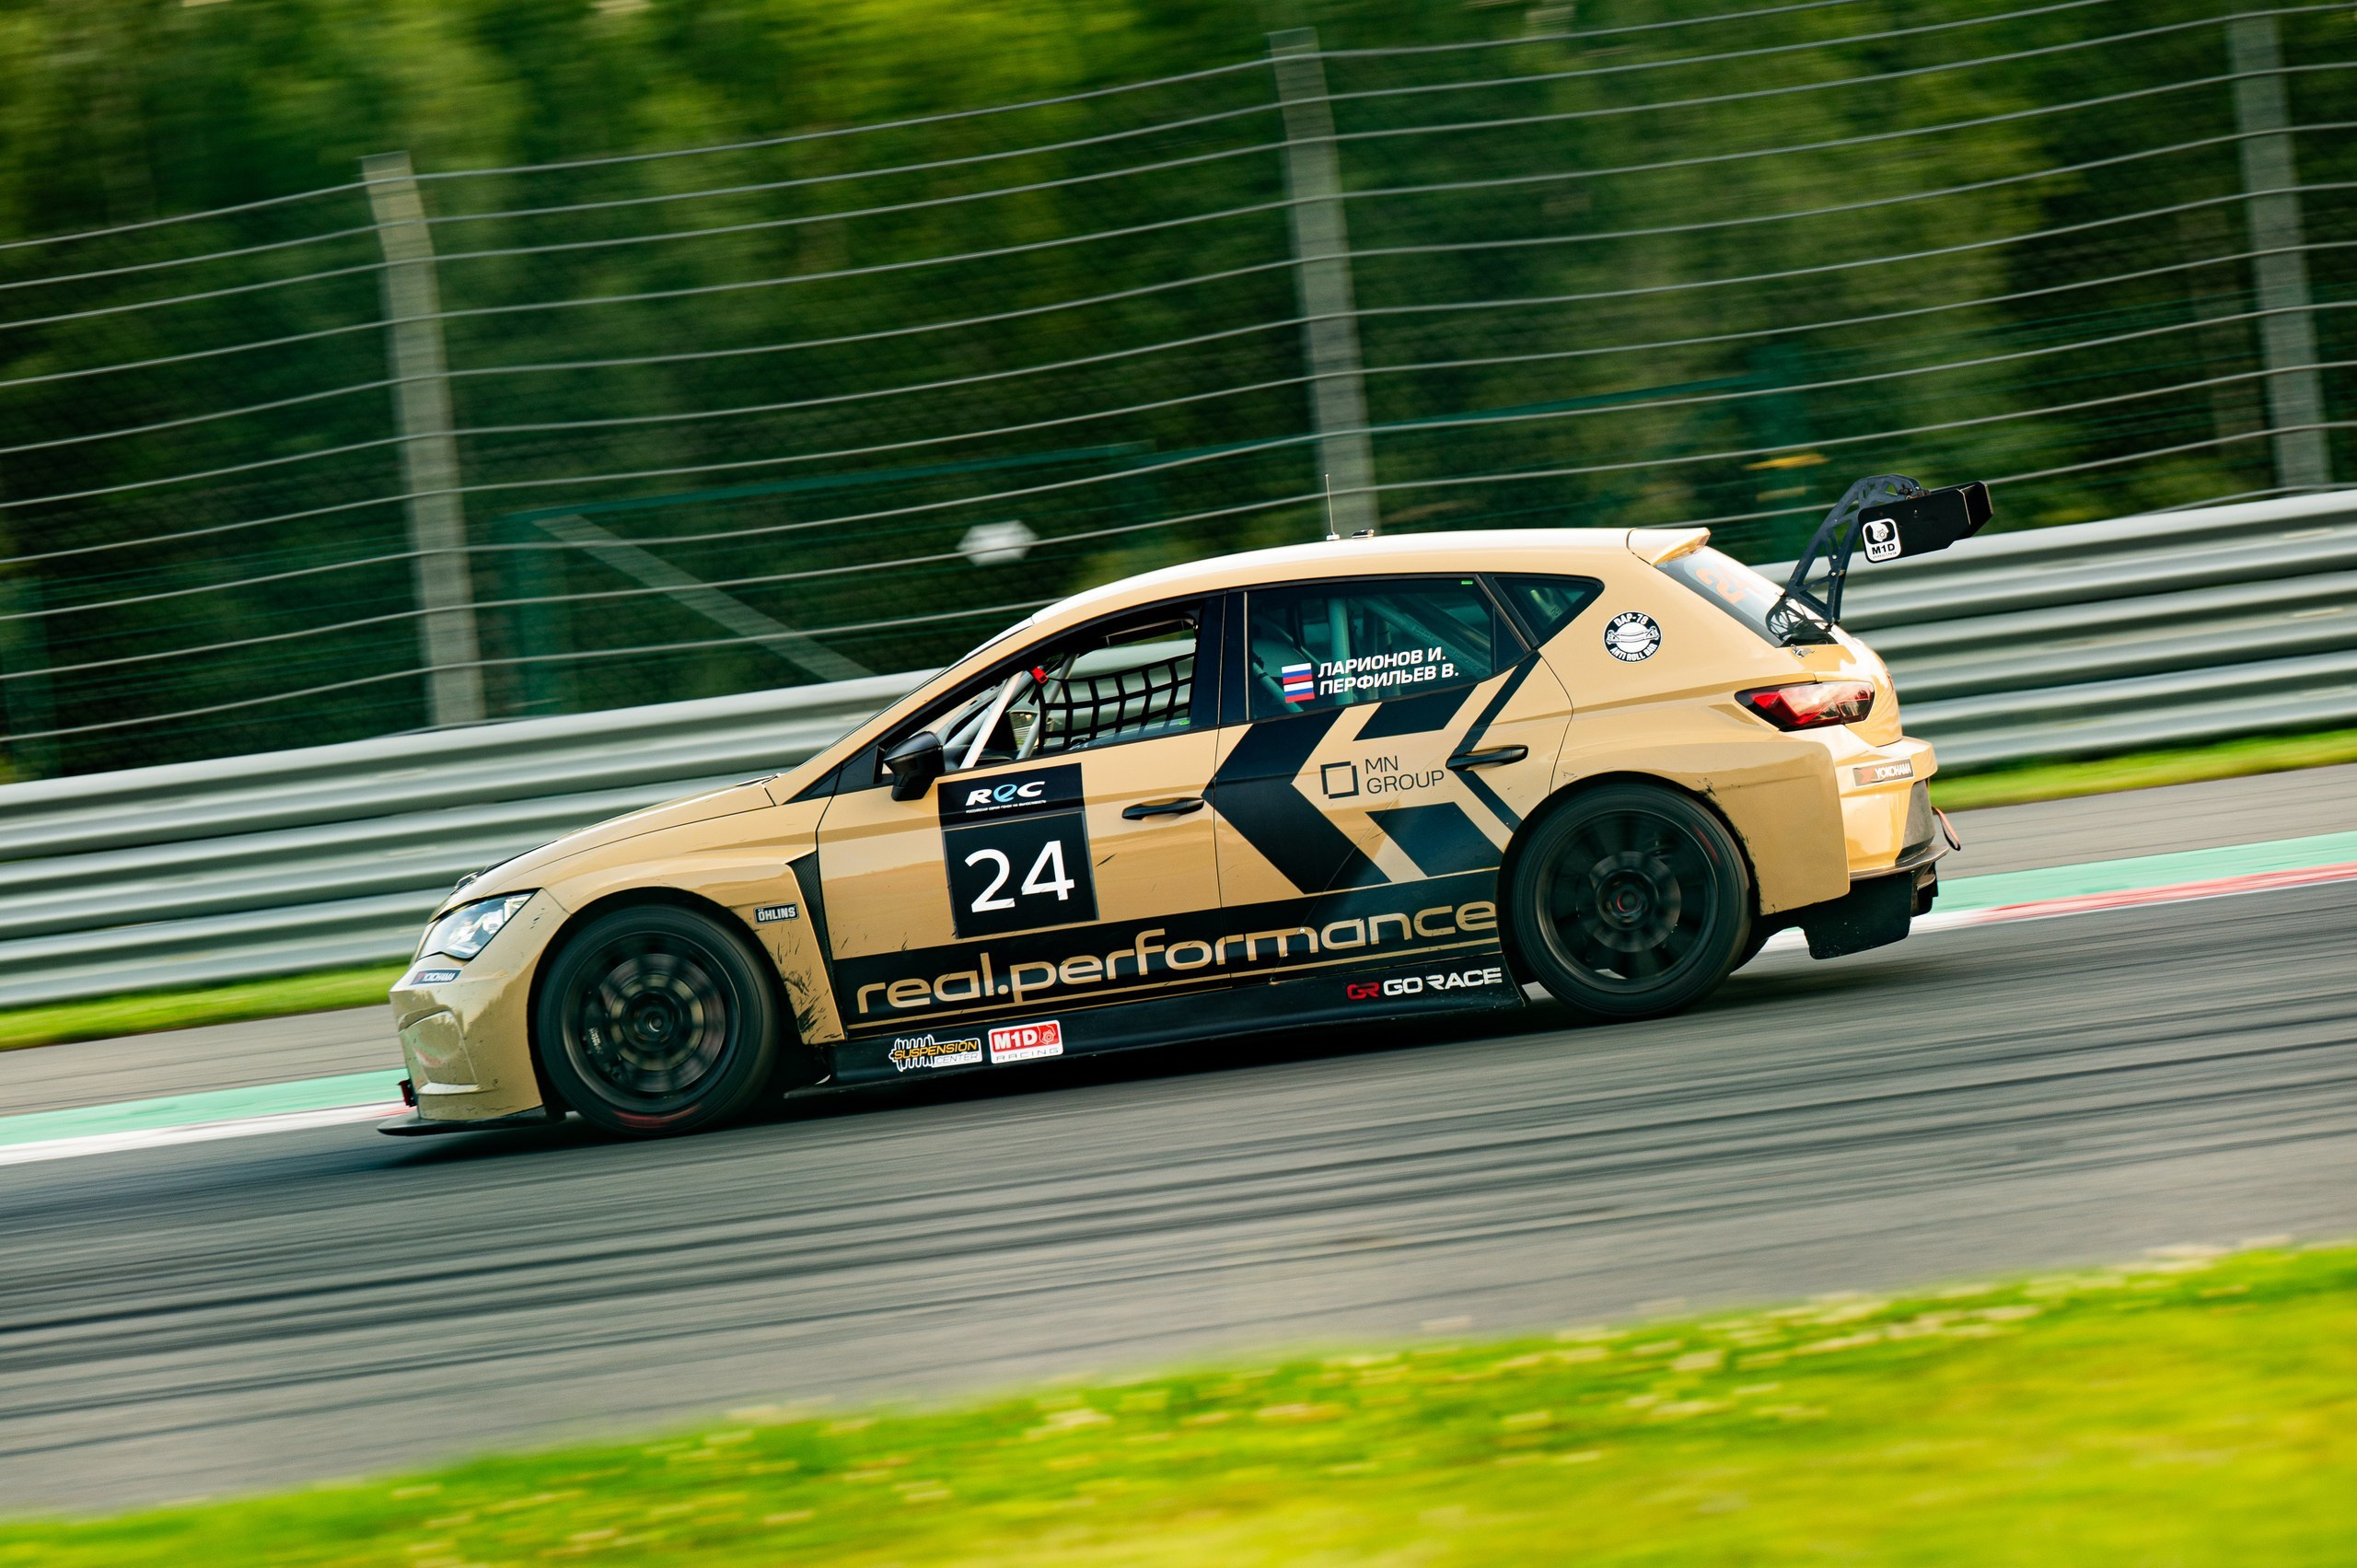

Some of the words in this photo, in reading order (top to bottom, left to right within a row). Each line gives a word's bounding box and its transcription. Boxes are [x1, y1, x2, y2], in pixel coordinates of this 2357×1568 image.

[1871, 543, 1896, 555] M1D
[1613, 613, 1649, 627] DAP-78
[1318, 649, 1423, 678] ЛАРИОНОВ
[1427, 646, 1447, 662] И.
[1609, 646, 1628, 659] ANTI
[1626, 652, 1646, 661] ROLL
[1318, 666, 1436, 695] ПЕРФИЛЬЕВ
[1441, 663, 1459, 679] В.
[1364, 755, 1399, 774] MN
[1875, 762, 1913, 779] YOKOHAMA
[1366, 770, 1446, 795] GROUP
[964, 840, 1075, 913] 24
[757, 906, 796, 922] ÖHLINS
[856, 900, 1499, 1015] real.performance
[1347, 981, 1380, 1001] GR
[1383, 977, 1423, 996] GO
[1425, 967, 1503, 991] RACE
[994, 1029, 1038, 1050] M1D
[894, 1040, 979, 1061] SUSPENSION
[935, 1051, 979, 1065] CENTER
[995, 1047, 1059, 1063] RACING
